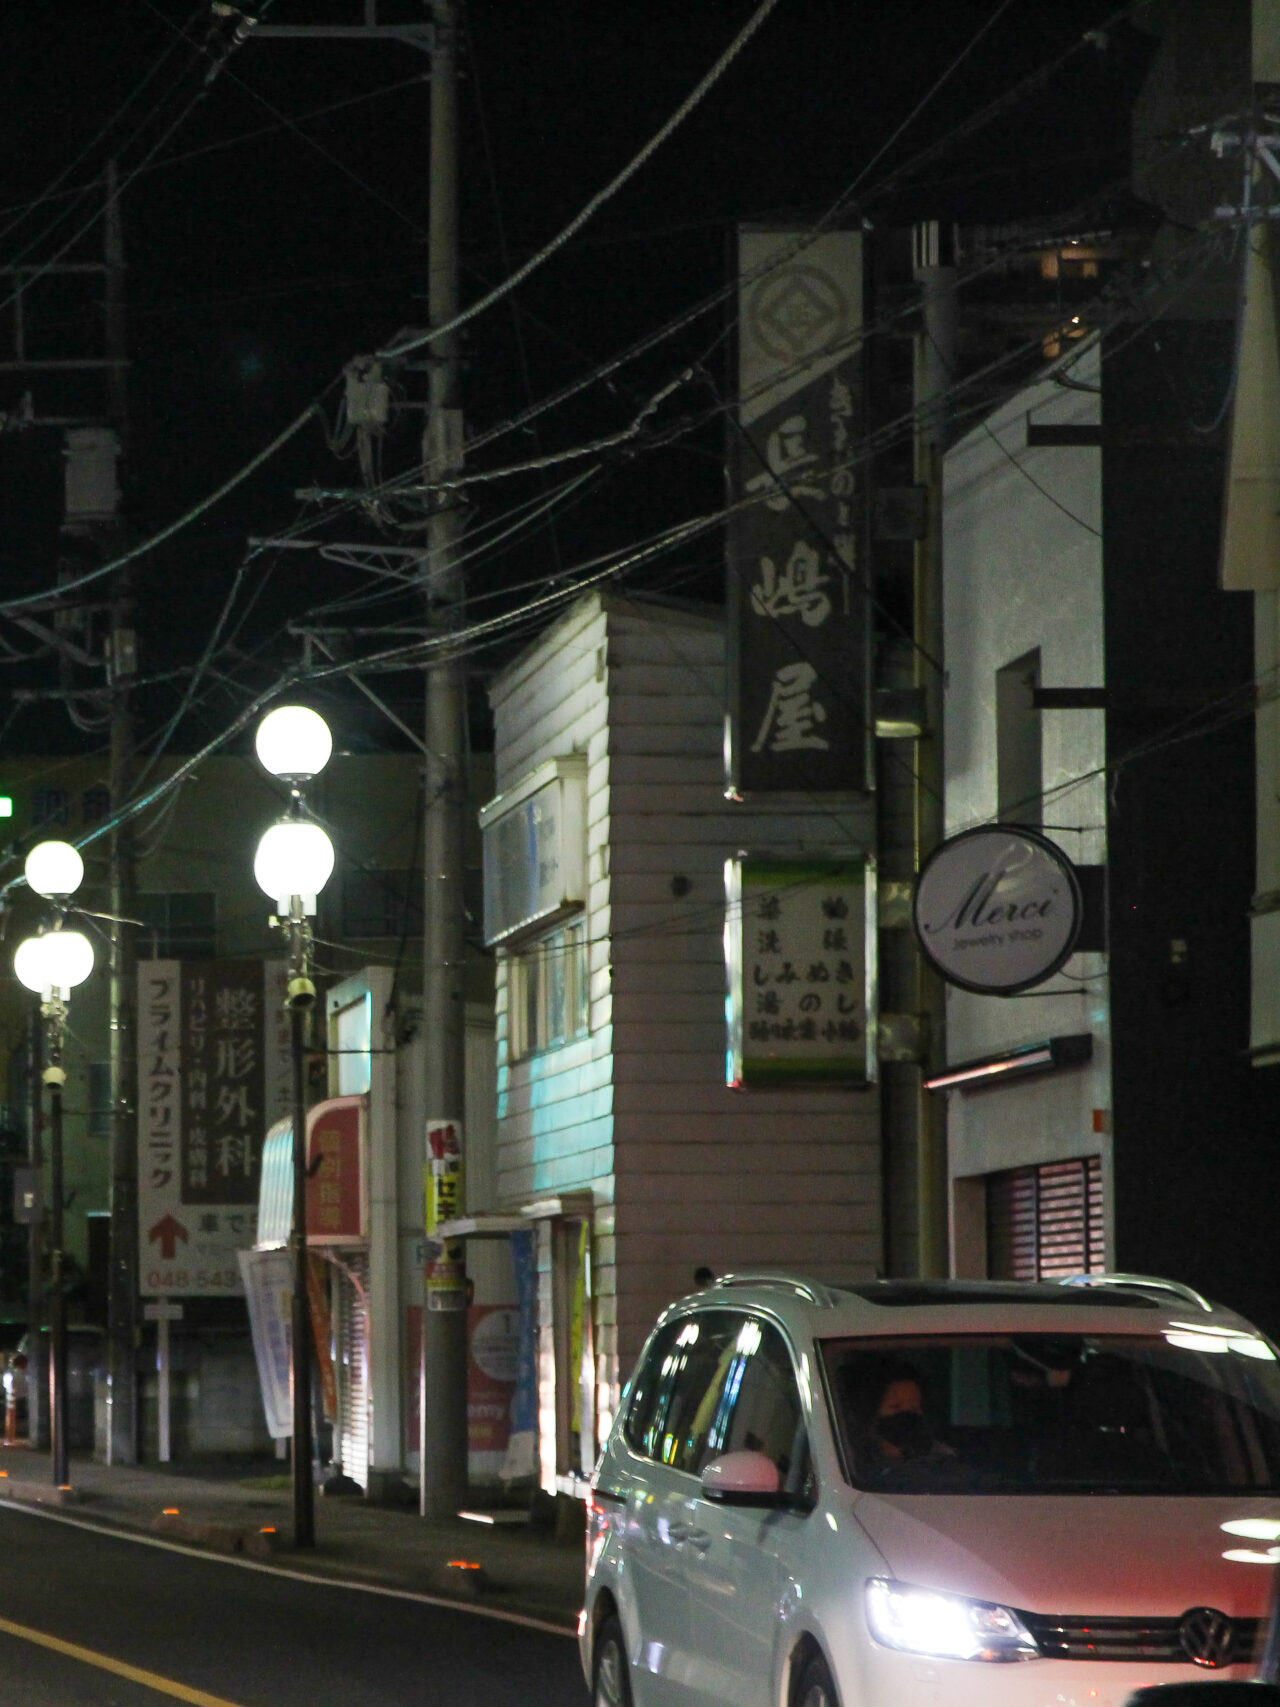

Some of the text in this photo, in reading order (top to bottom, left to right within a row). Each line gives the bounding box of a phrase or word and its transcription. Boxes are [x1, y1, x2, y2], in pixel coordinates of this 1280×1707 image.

[924, 870, 1059, 934] Merci
[1008, 928, 1043, 943] shop
[216, 988, 257, 1178] 整形外科
